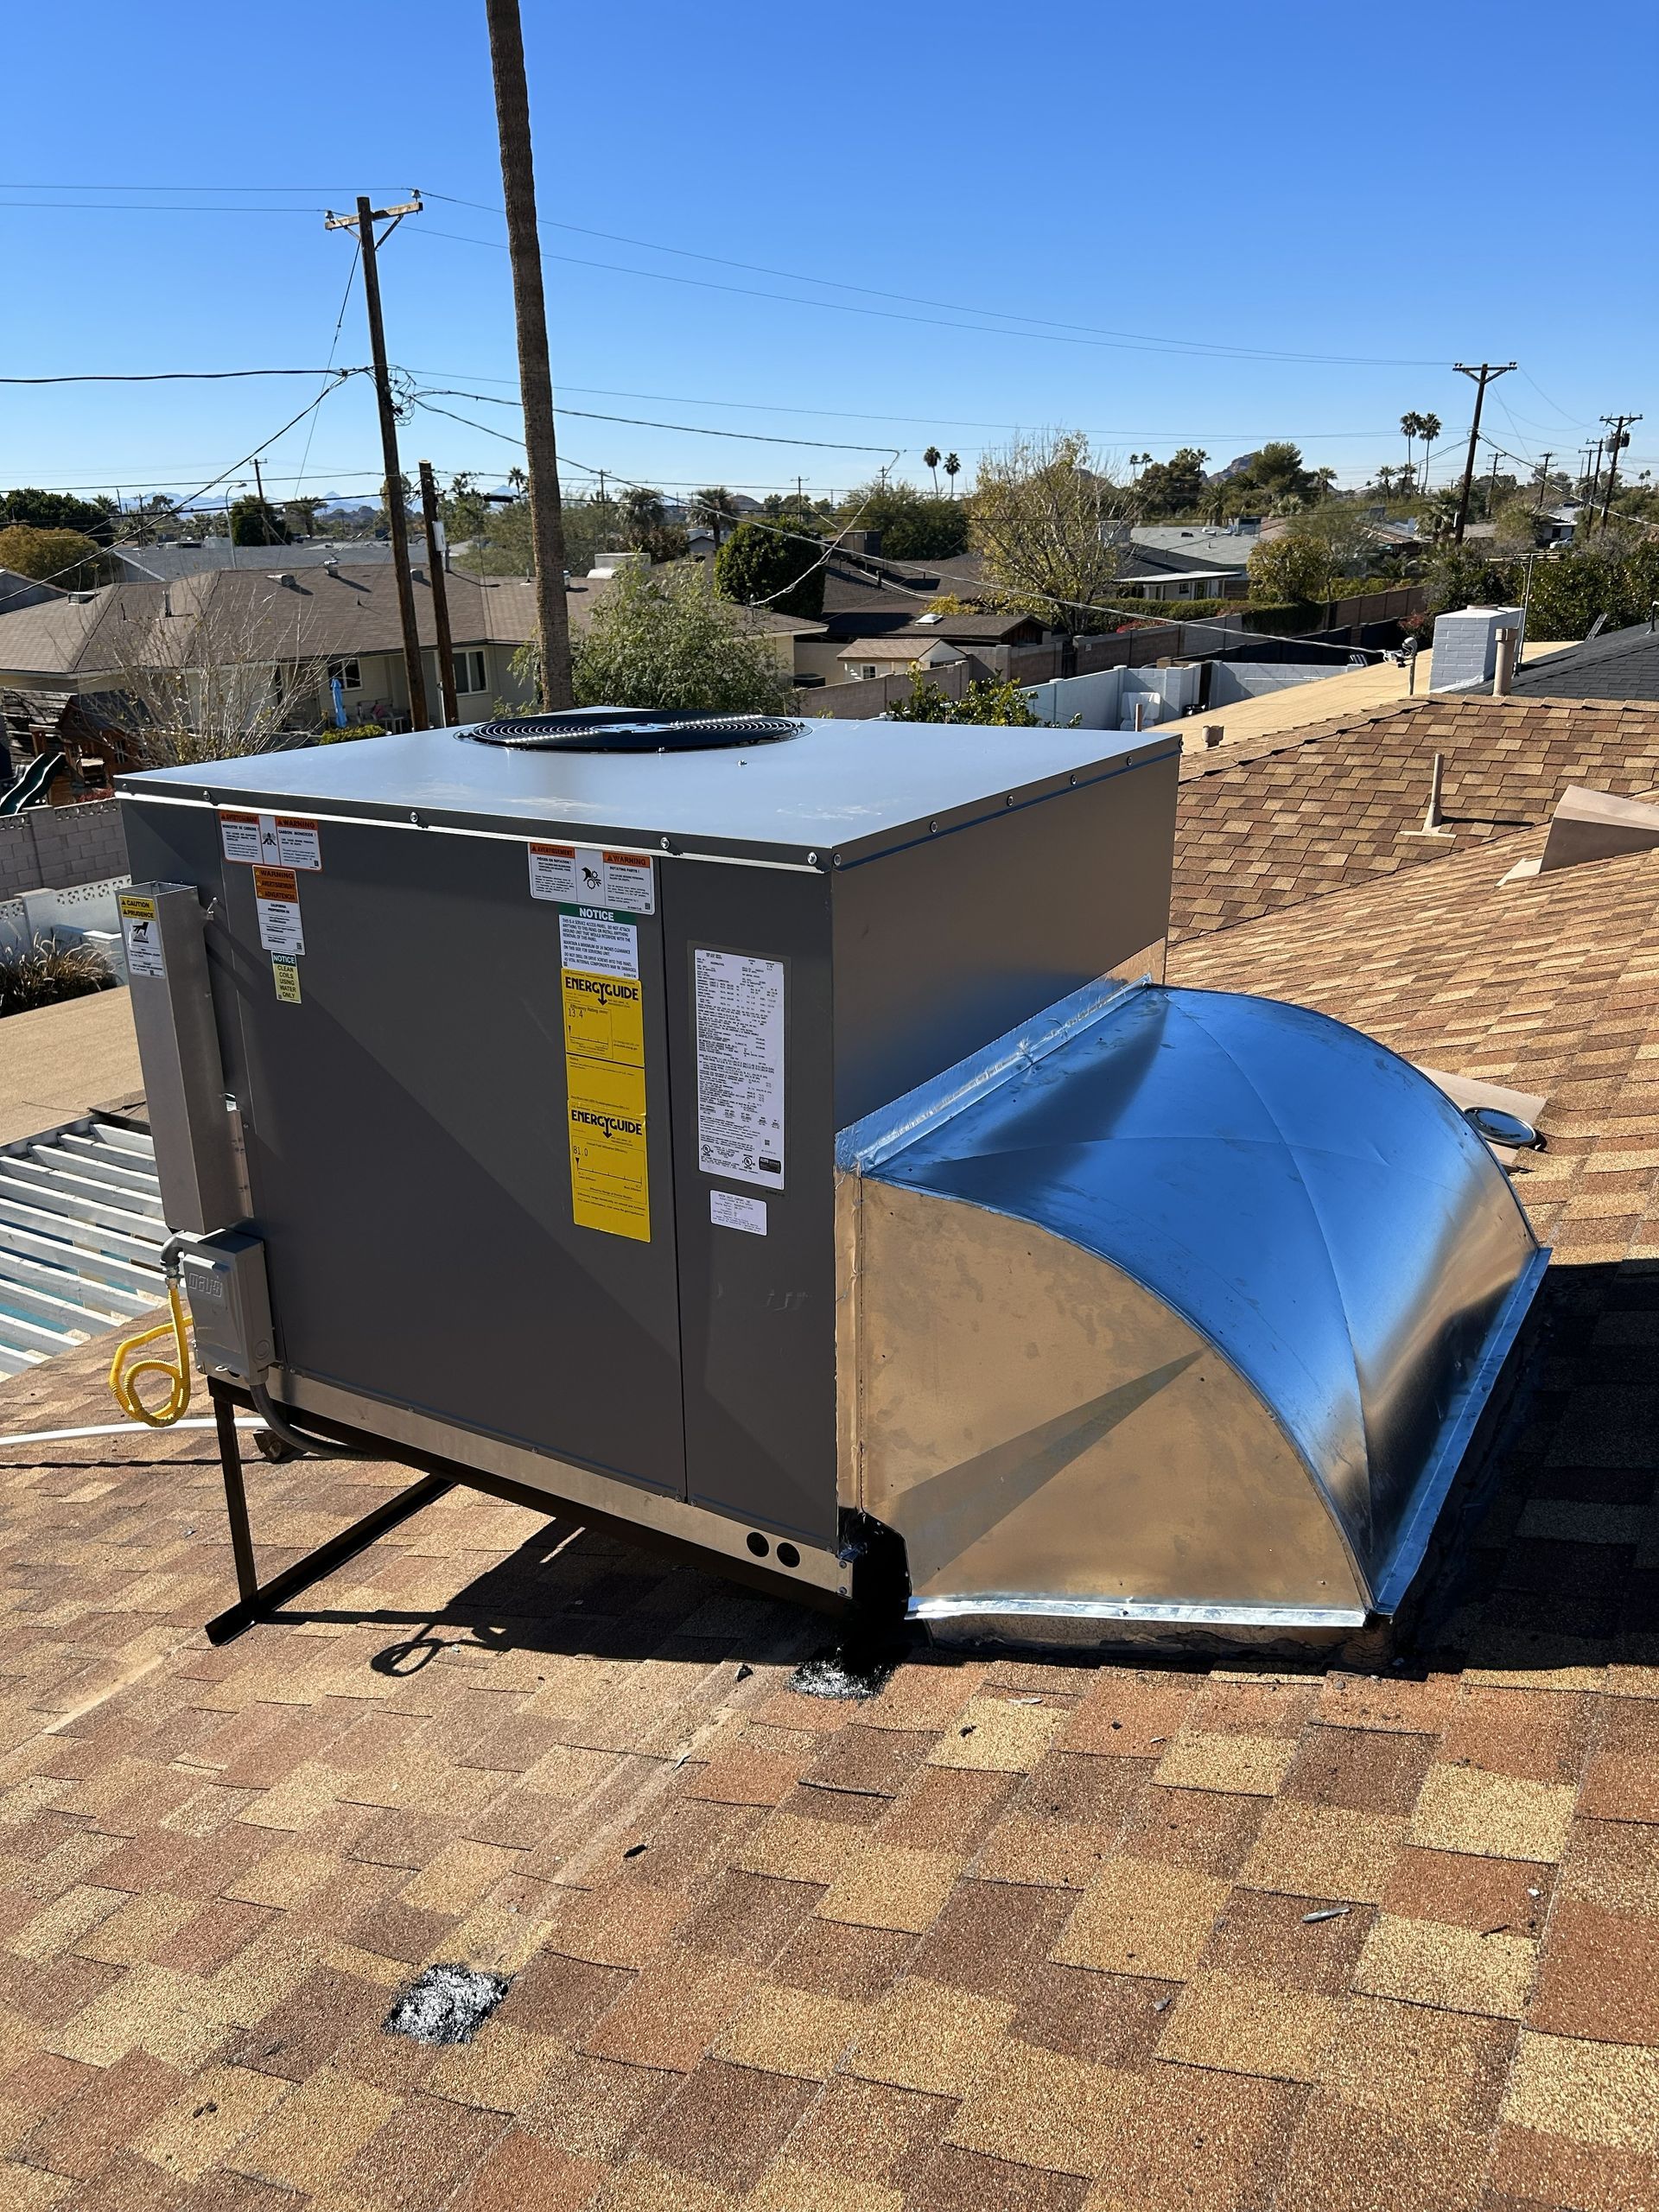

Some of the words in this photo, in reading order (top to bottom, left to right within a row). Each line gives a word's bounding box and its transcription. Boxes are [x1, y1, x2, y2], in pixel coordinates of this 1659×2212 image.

[283, 819, 315, 829] WARNING
[613, 856, 645, 865] WARNING
[260, 869, 294, 880] WARNING
[579, 907, 614, 921] NOTICE
[273, 955, 295, 964] NOTICE
[565, 976, 639, 1001] ENERGYGUIDE
[571, 1109, 642, 1136] ENERGYGUIDE
[574, 1145, 588, 1157] 81.0
